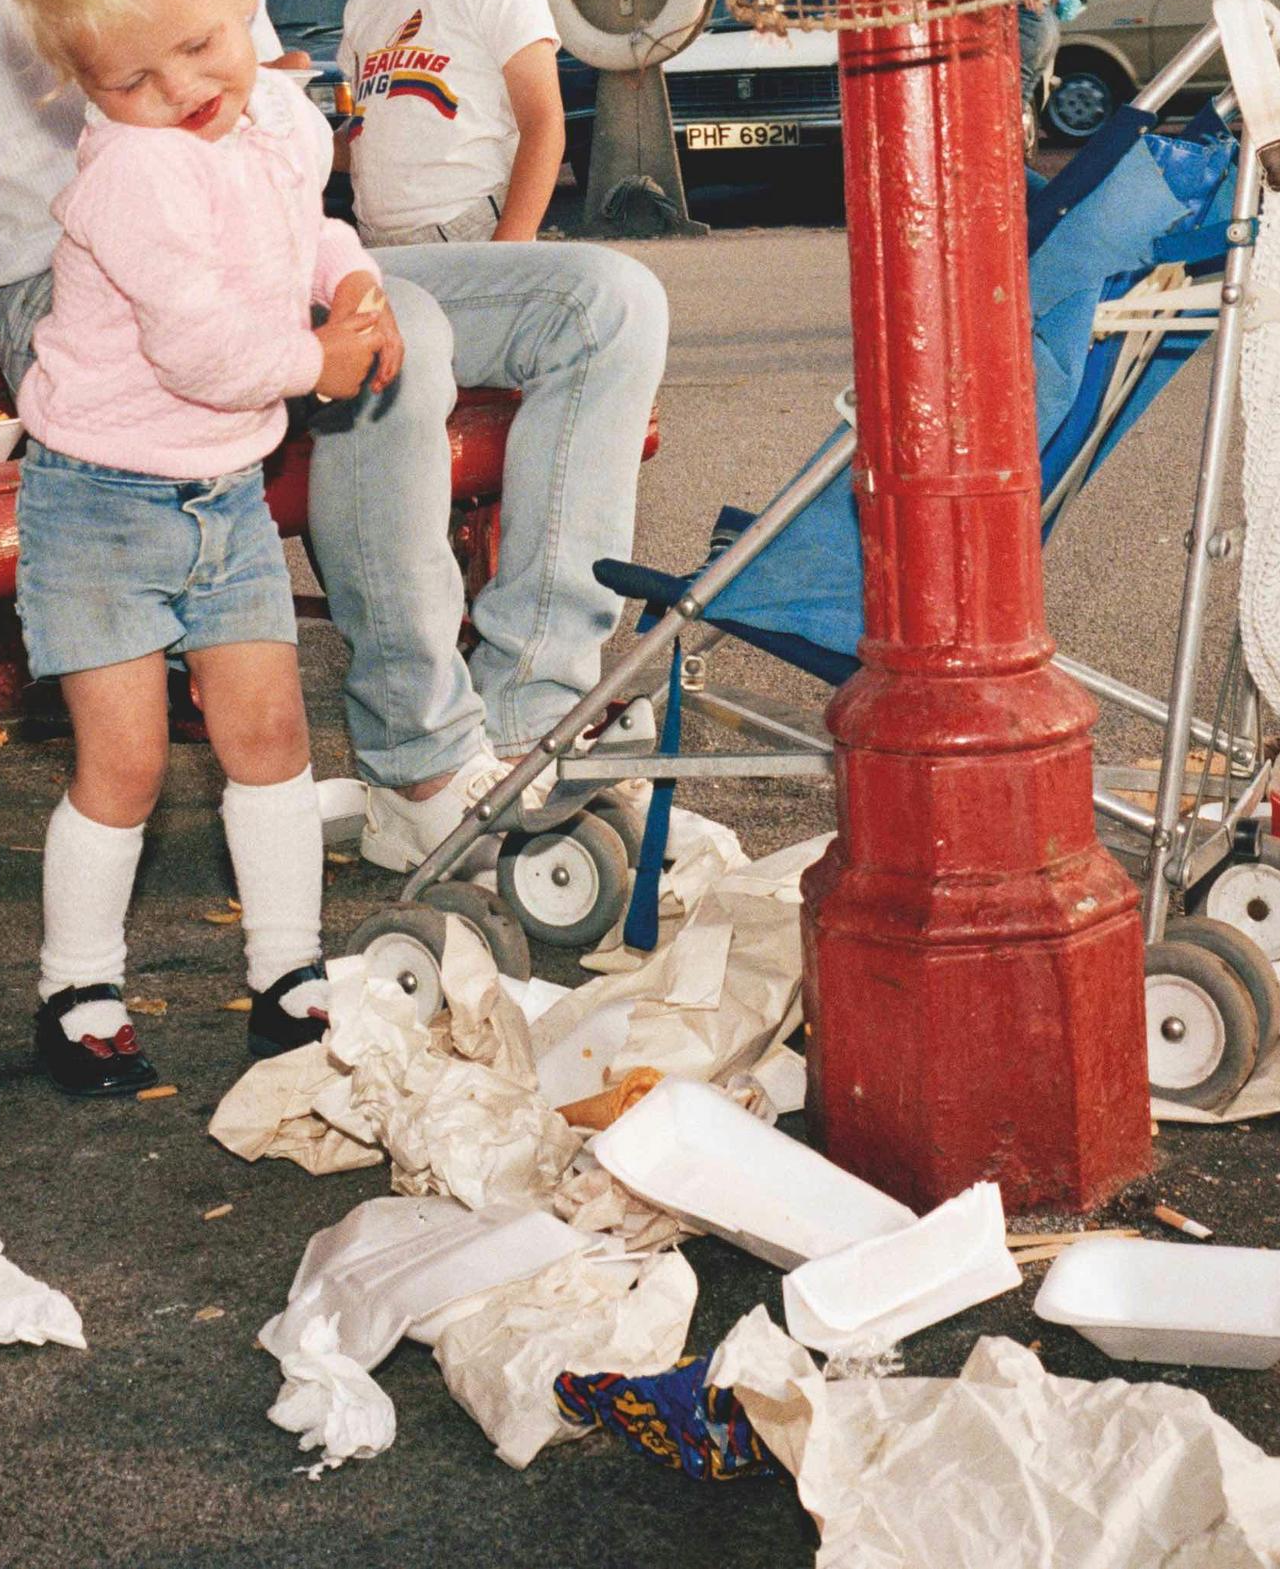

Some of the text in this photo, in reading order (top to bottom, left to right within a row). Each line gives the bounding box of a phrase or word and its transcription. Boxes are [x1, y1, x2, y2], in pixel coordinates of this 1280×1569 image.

[362, 50, 450, 80] SAILING
[358, 74, 389, 102] ING
[688, 124, 798, 146] PHF 692M
